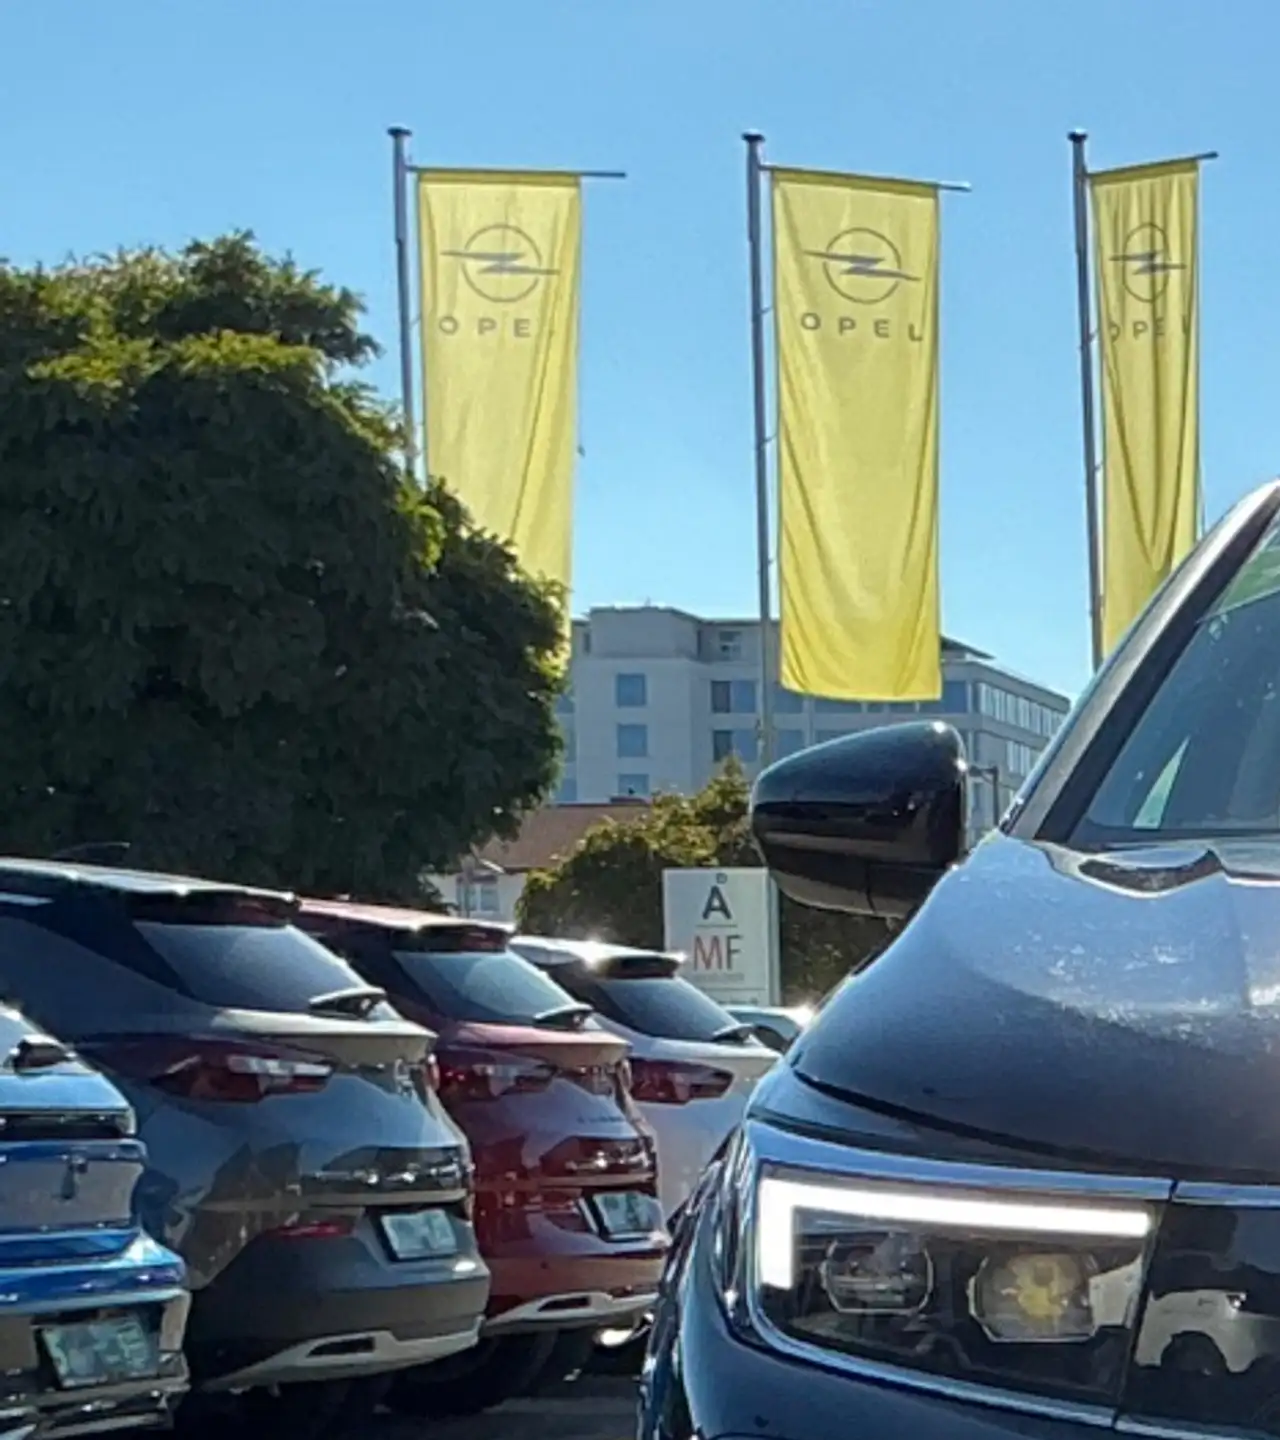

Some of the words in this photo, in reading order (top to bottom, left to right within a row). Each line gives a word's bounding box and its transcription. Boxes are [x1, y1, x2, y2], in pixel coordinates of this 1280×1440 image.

[800, 312, 924, 343] OPEL
[702, 885, 732, 920] A
[692, 934, 745, 971] MF
